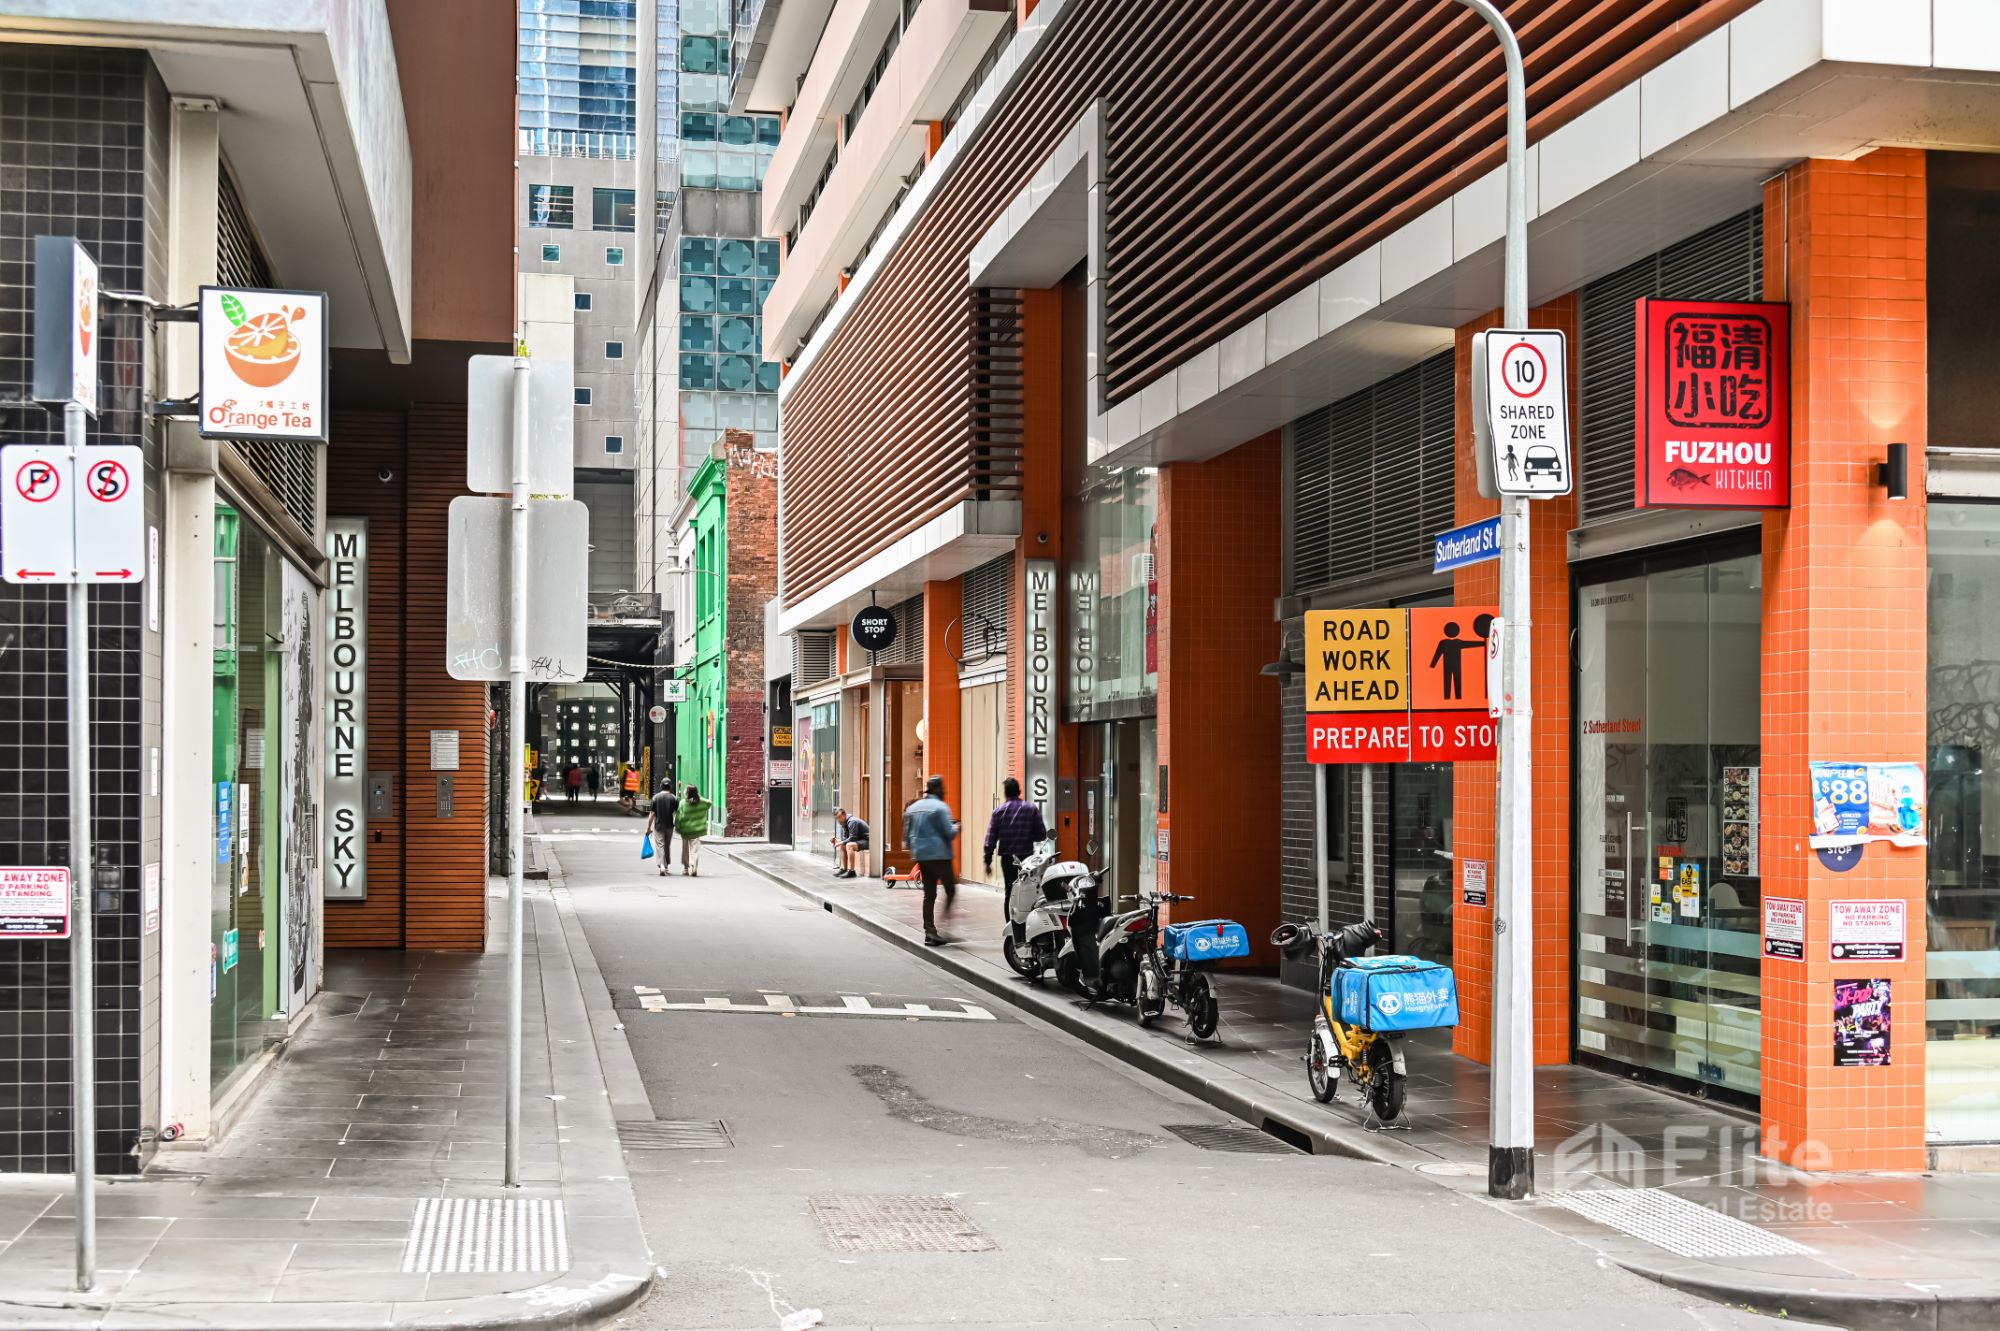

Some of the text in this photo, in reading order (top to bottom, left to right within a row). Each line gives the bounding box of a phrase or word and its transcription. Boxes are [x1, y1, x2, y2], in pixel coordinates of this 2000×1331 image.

[1673, 322, 1764, 370] 福清
[1514, 359, 1535, 383] 10
[1674, 372, 1764, 420] 小吃
[209, 405, 312, 430] Orange Tea
[1500, 405, 1555, 419] SHARED
[1511, 424, 1546, 439] ZONE
[1665, 440, 1772, 465] FUZHOU
[1715, 469, 1772, 490] KITCHEN
[1436, 527, 1493, 563] Sutherland St
[861, 618, 888, 626] SHORT
[1323, 619, 1390, 641] ROAD
[333, 533, 357, 777] MELBOURNE
[1032, 571, 1049, 755] MELBOURNE
[1322, 650, 1391, 671] WORK
[1315, 679, 1400, 701] AHEAD
[1313, 724, 1498, 749] PREPARE TO STO
[1583, 720, 1588, 734] 2
[1588, 719, 1621, 734] Sutherland
[333, 808, 355, 888] SKY
[1827, 846, 1853, 854] STOP
[4, 873, 64, 882] AWAY ZONE
[1766, 902, 1802, 913] TOW AWAY ZONE
[1834, 905, 1900, 914] TOW AWAY ZONE
